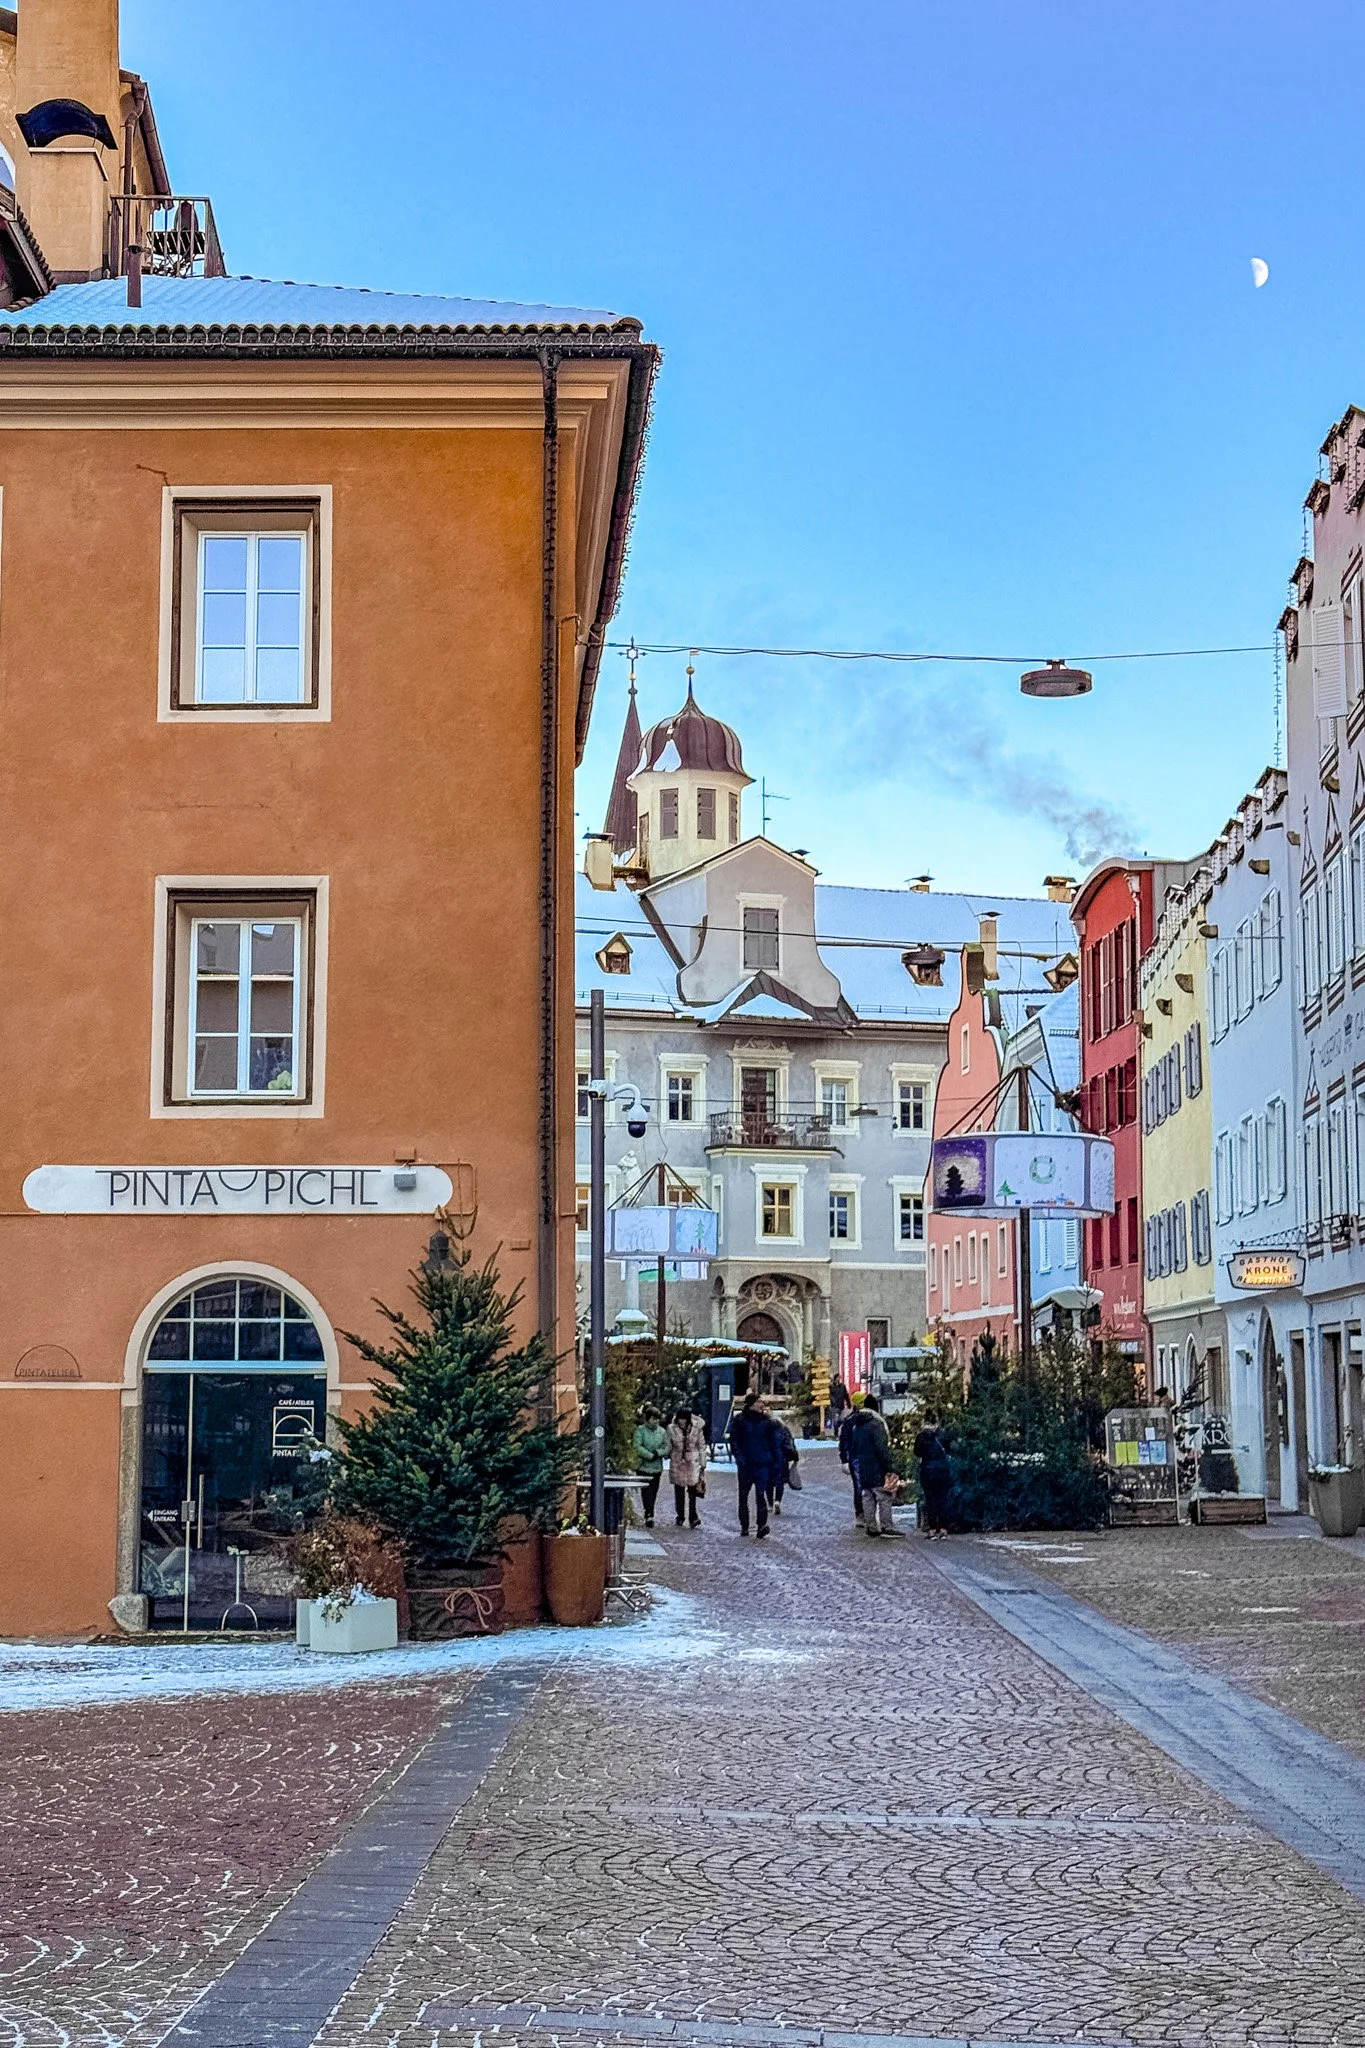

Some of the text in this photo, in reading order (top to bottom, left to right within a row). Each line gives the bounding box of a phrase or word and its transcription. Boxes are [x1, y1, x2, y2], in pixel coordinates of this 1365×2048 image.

[110, 1170, 379, 1206] PINTA PICHL
[1239, 1256, 1292, 1266] GASTHOF
[1245, 1265, 1288, 1275] KRONE
